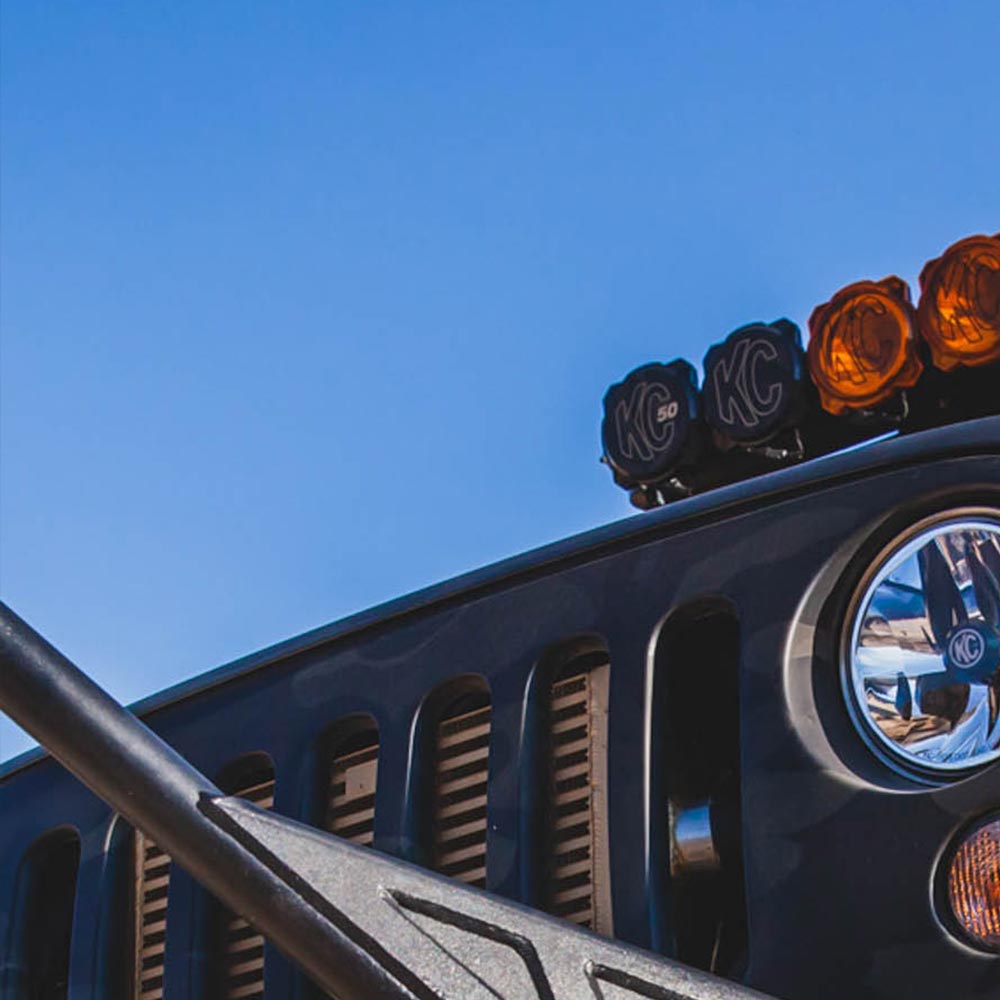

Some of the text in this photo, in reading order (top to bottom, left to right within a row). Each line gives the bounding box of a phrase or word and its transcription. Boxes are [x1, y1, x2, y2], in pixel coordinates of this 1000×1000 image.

[713, 338, 782, 426] KC
[615, 381, 674, 461] KC
[656, 401, 679, 423] 50
[953, 633, 980, 664] KC
